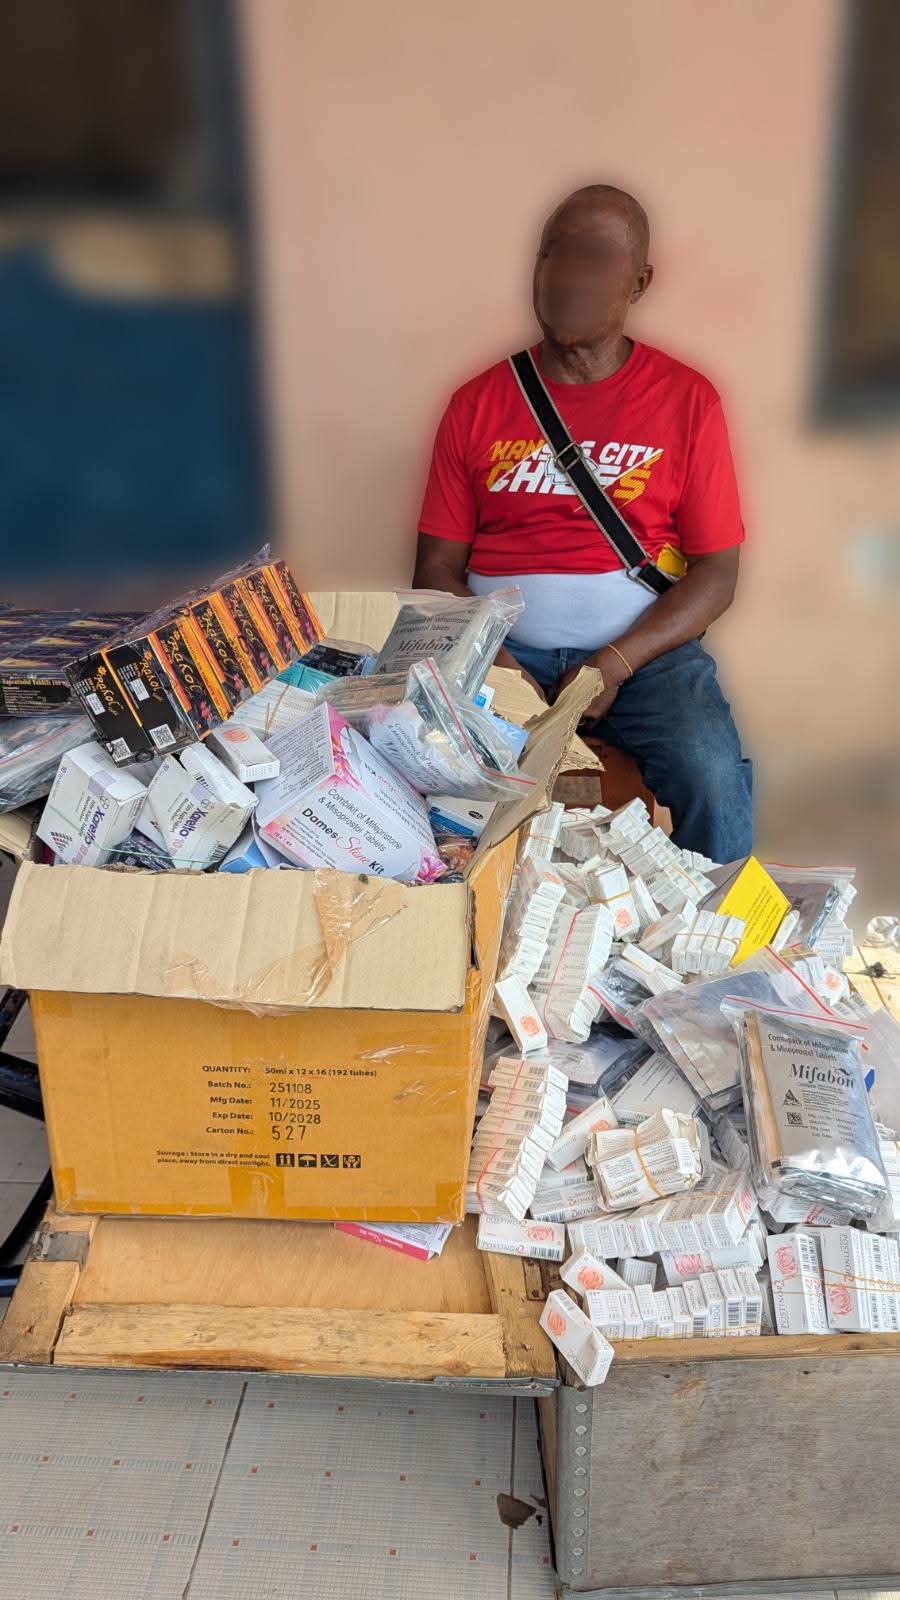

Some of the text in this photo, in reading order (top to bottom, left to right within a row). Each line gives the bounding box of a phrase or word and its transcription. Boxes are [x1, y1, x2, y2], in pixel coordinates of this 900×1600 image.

[490, 440, 664, 467] KANSS CITY
[83, 807, 105, 846] Xarelto
[179, 808, 207, 839] Xarelto
[317, 795, 327, 804] &
[363, 830, 387, 852] Tablets
[327, 787, 359, 816] Combikit
[355, 811, 366, 821] of
[363, 816, 403, 851] Mifepristone
[301, 806, 340, 840] Dames
[368, 859, 385, 875] Kit
[202, 1065, 251, 1073] QUANTITY:
[350, 1070, 377, 1078] tubes)
[790, 1064, 855, 1088] Mifabon
[269, 1082, 312, 1094] 251108
[210, 1097, 320, 1110] Mfg Date: 11/2025
[212, 1112, 321, 1124] Exp Date: 10/2028
